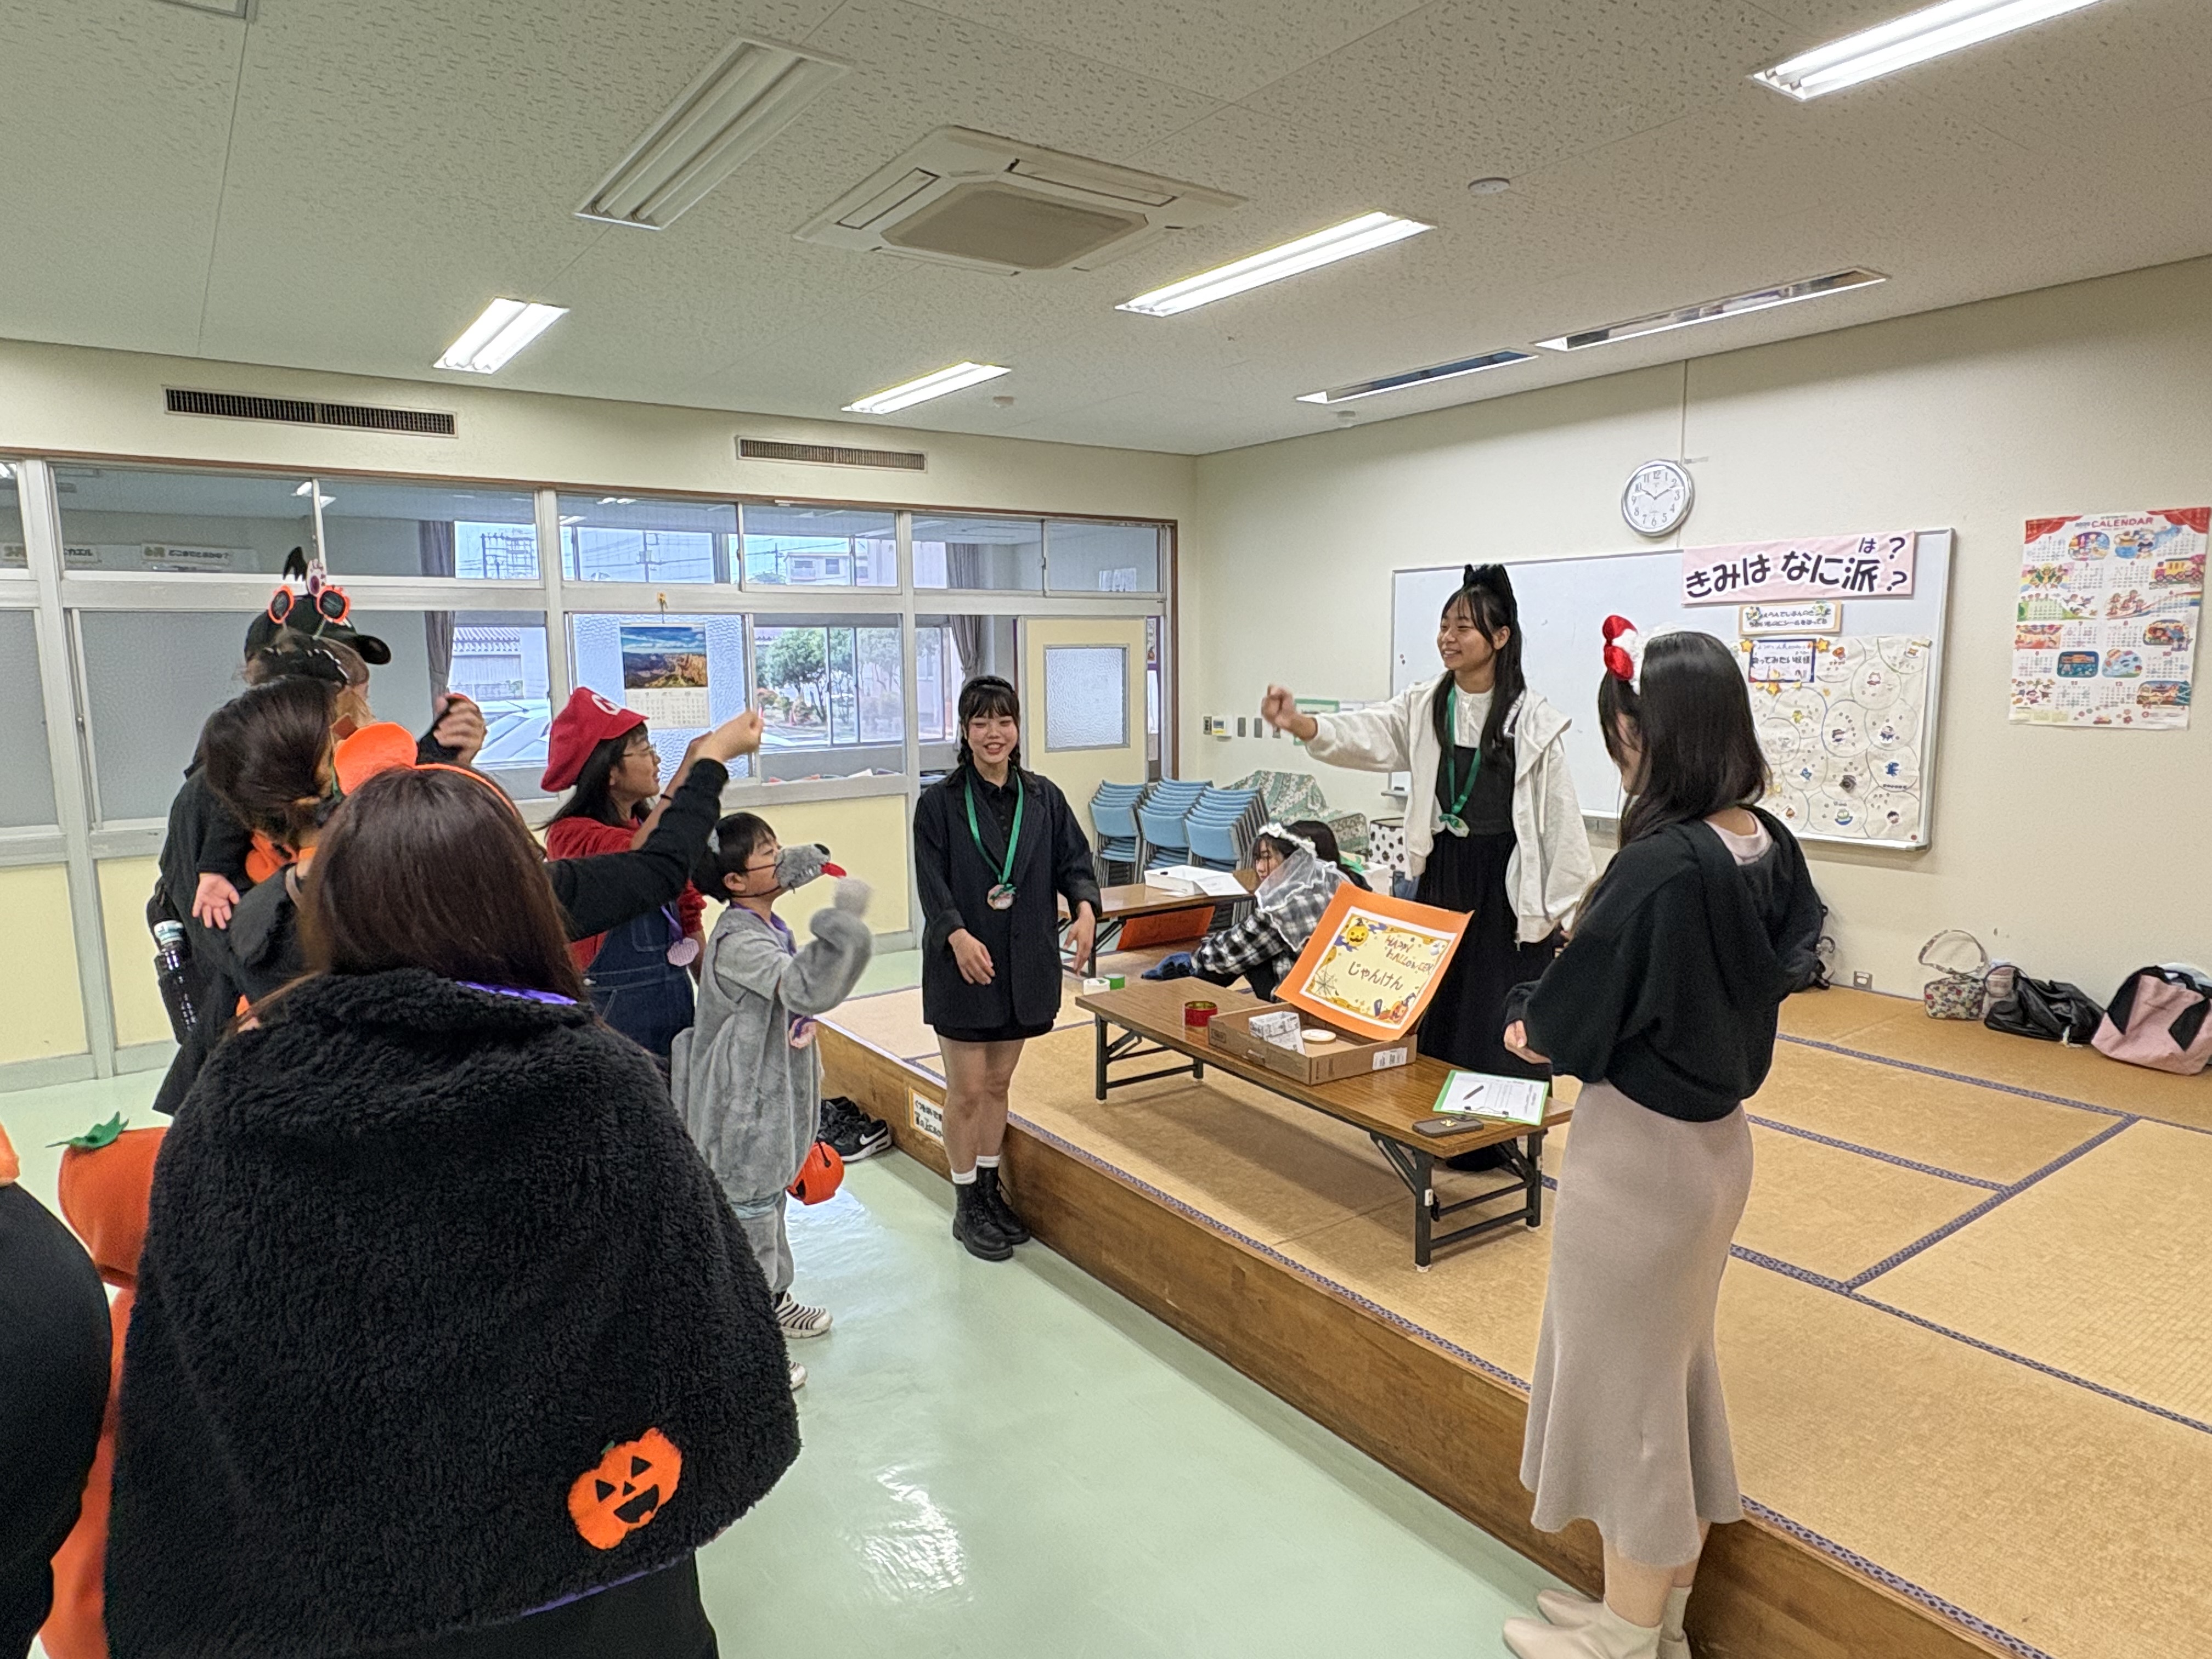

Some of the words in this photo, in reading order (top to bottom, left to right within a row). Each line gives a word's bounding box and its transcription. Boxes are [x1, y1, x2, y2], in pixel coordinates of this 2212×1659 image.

[1644, 473, 1649, 483] 11
[1631, 495, 1637, 505] 9
[1674, 490, 1680, 501] 3
[1634, 507, 1639, 516] 8
[1669, 504, 1675, 513] 4
[1642, 514, 1647, 524] 7
[1651, 517, 1657, 527] 6
[1662, 512, 1668, 523] 5
[2091, 517, 2154, 528] CALENDAR
[1859, 537, 1877, 553] は
[1686, 554, 1770, 598] きみは
[1347, 961, 1403, 991] じゃんけん
